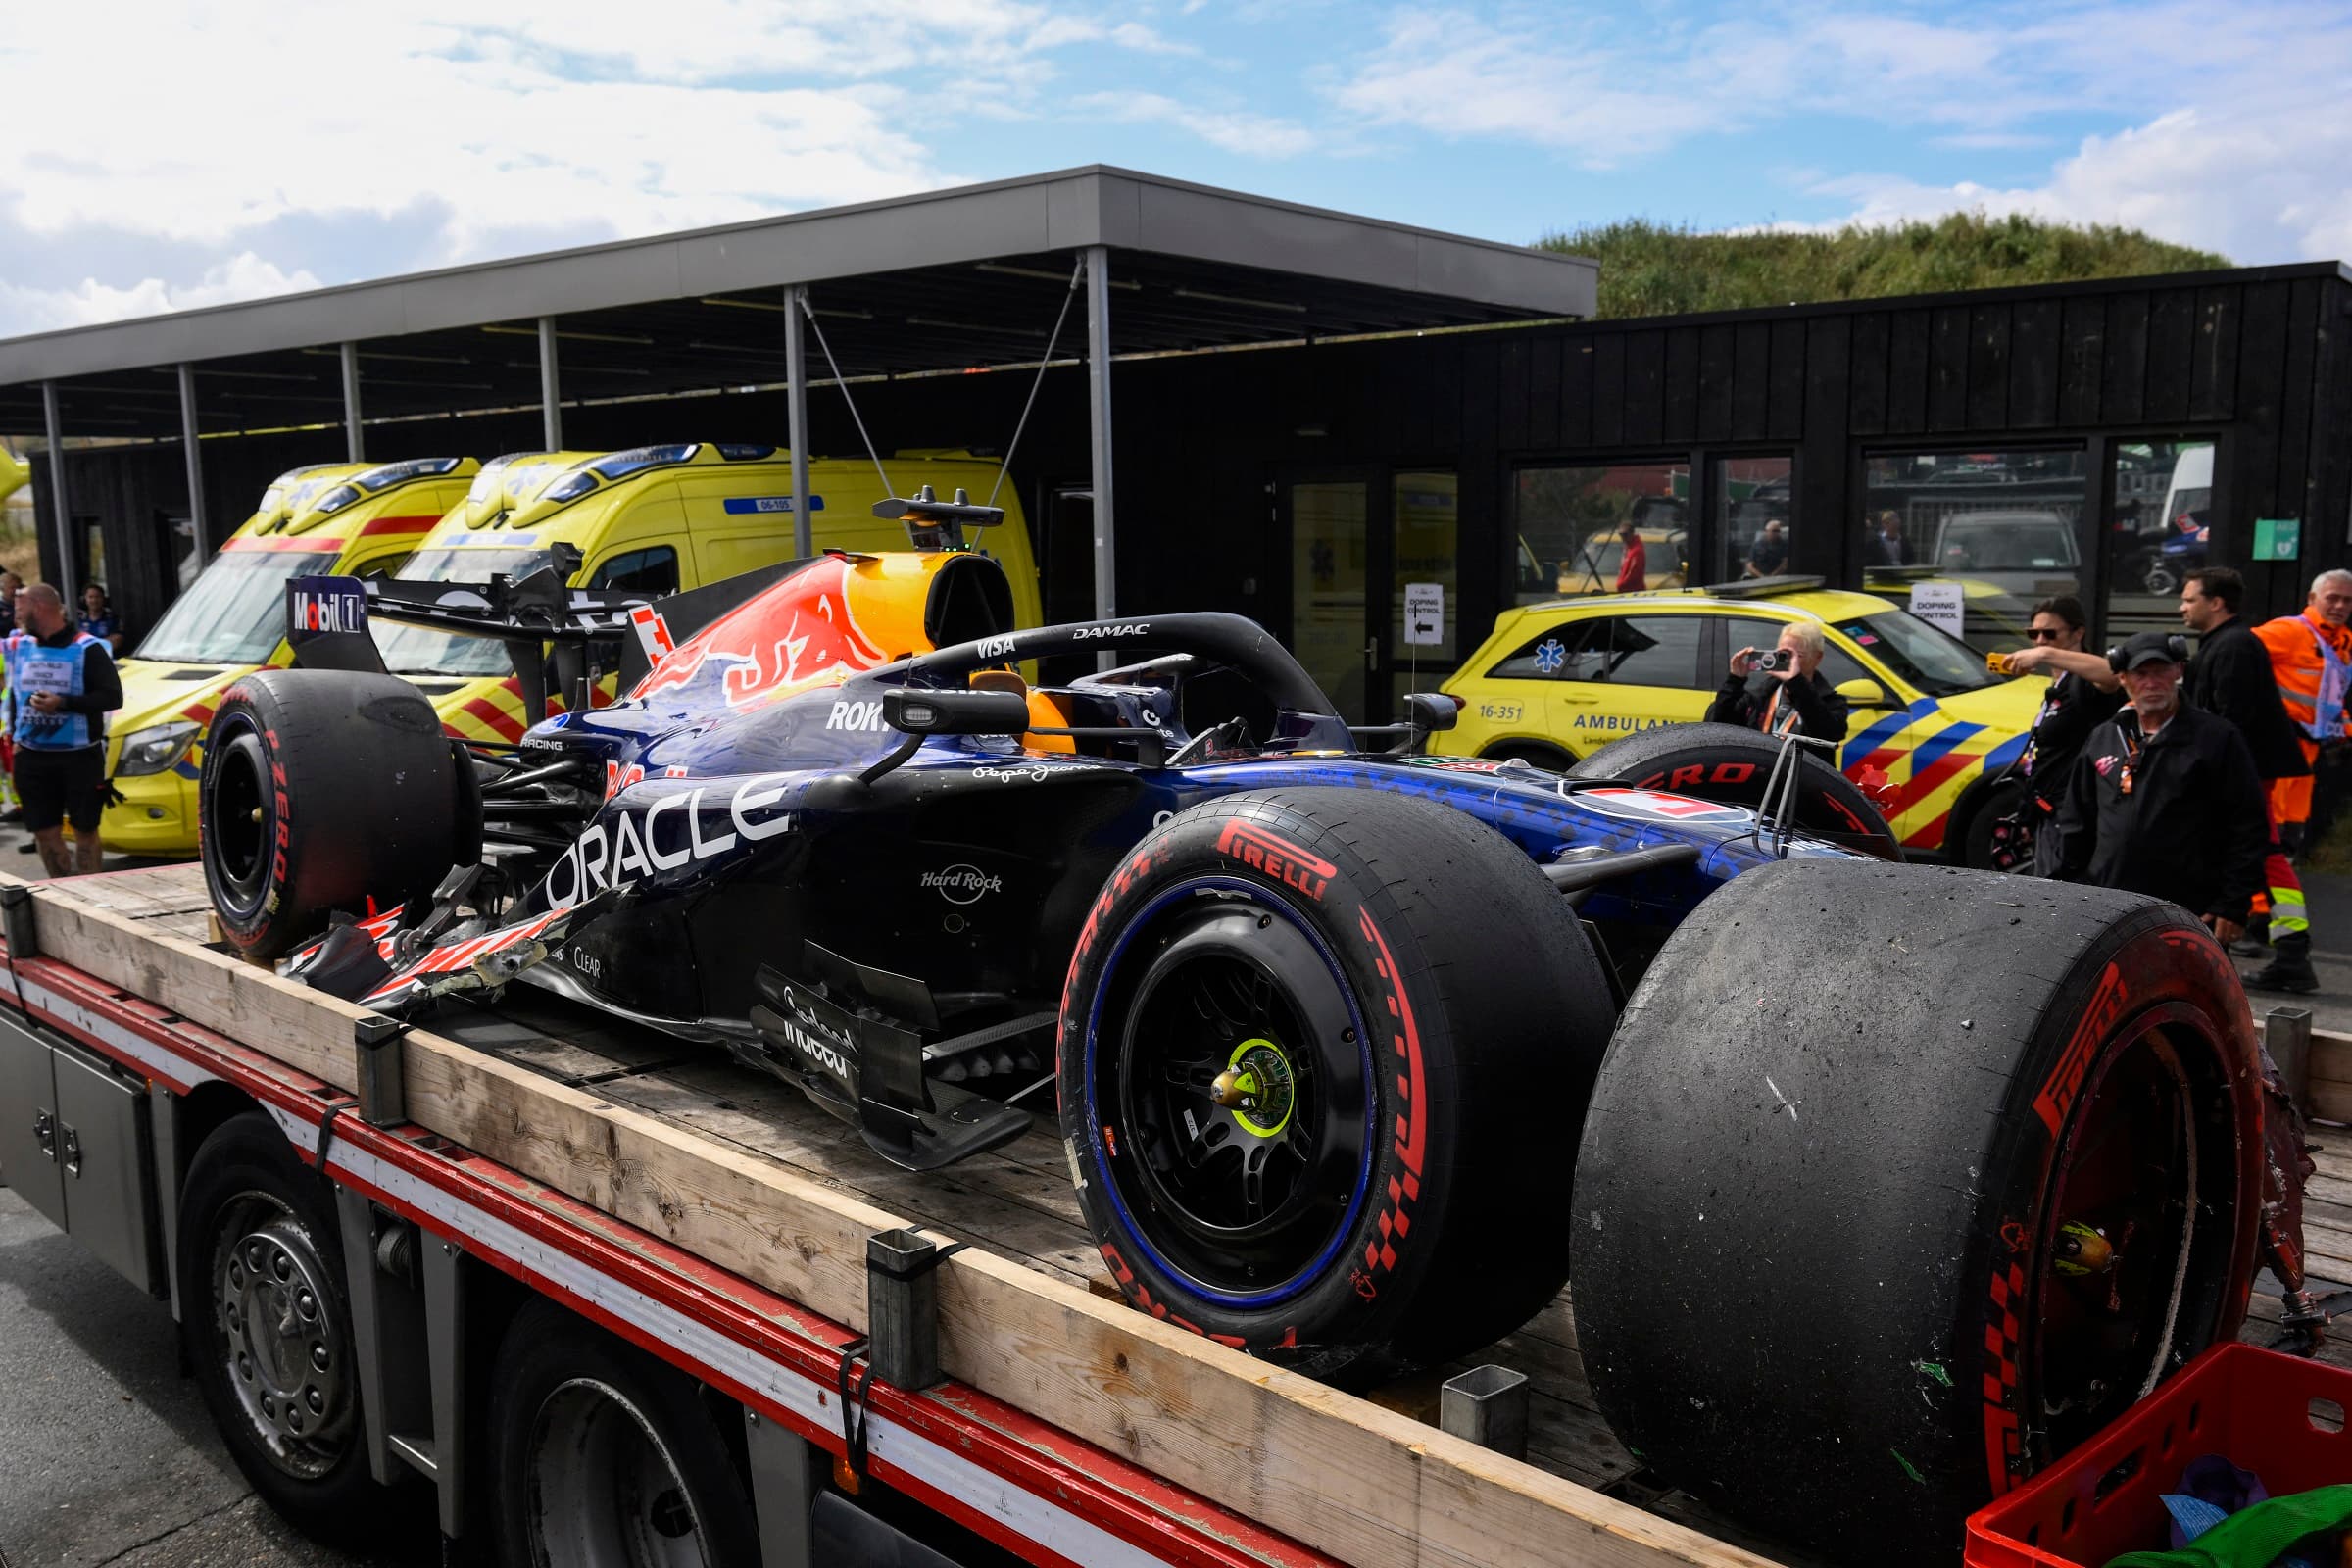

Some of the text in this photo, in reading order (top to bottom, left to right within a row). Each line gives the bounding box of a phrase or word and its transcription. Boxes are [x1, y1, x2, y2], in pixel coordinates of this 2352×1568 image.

[294, 592, 341, 632] Mobil
[1073, 623, 1151, 640] DAMAC
[976, 637, 1016, 659] VISA
[1480, 705, 1522, 721] 16-351
[1574, 714, 1675, 732] AMBULA
[519, 737, 564, 752] RACING
[973, 764, 1101, 783] Pepe Jeans
[1635, 762, 1756, 790] ERO
[271, 761, 292, 883] ZERO
[546, 770, 805, 911] ORACLE
[1216, 817, 1338, 902] PIRELLI
[920, 872, 1002, 893] Hard Rock
[574, 946, 601, 979] CLEAR
[2032, 961, 2129, 1143] PIRELLI
